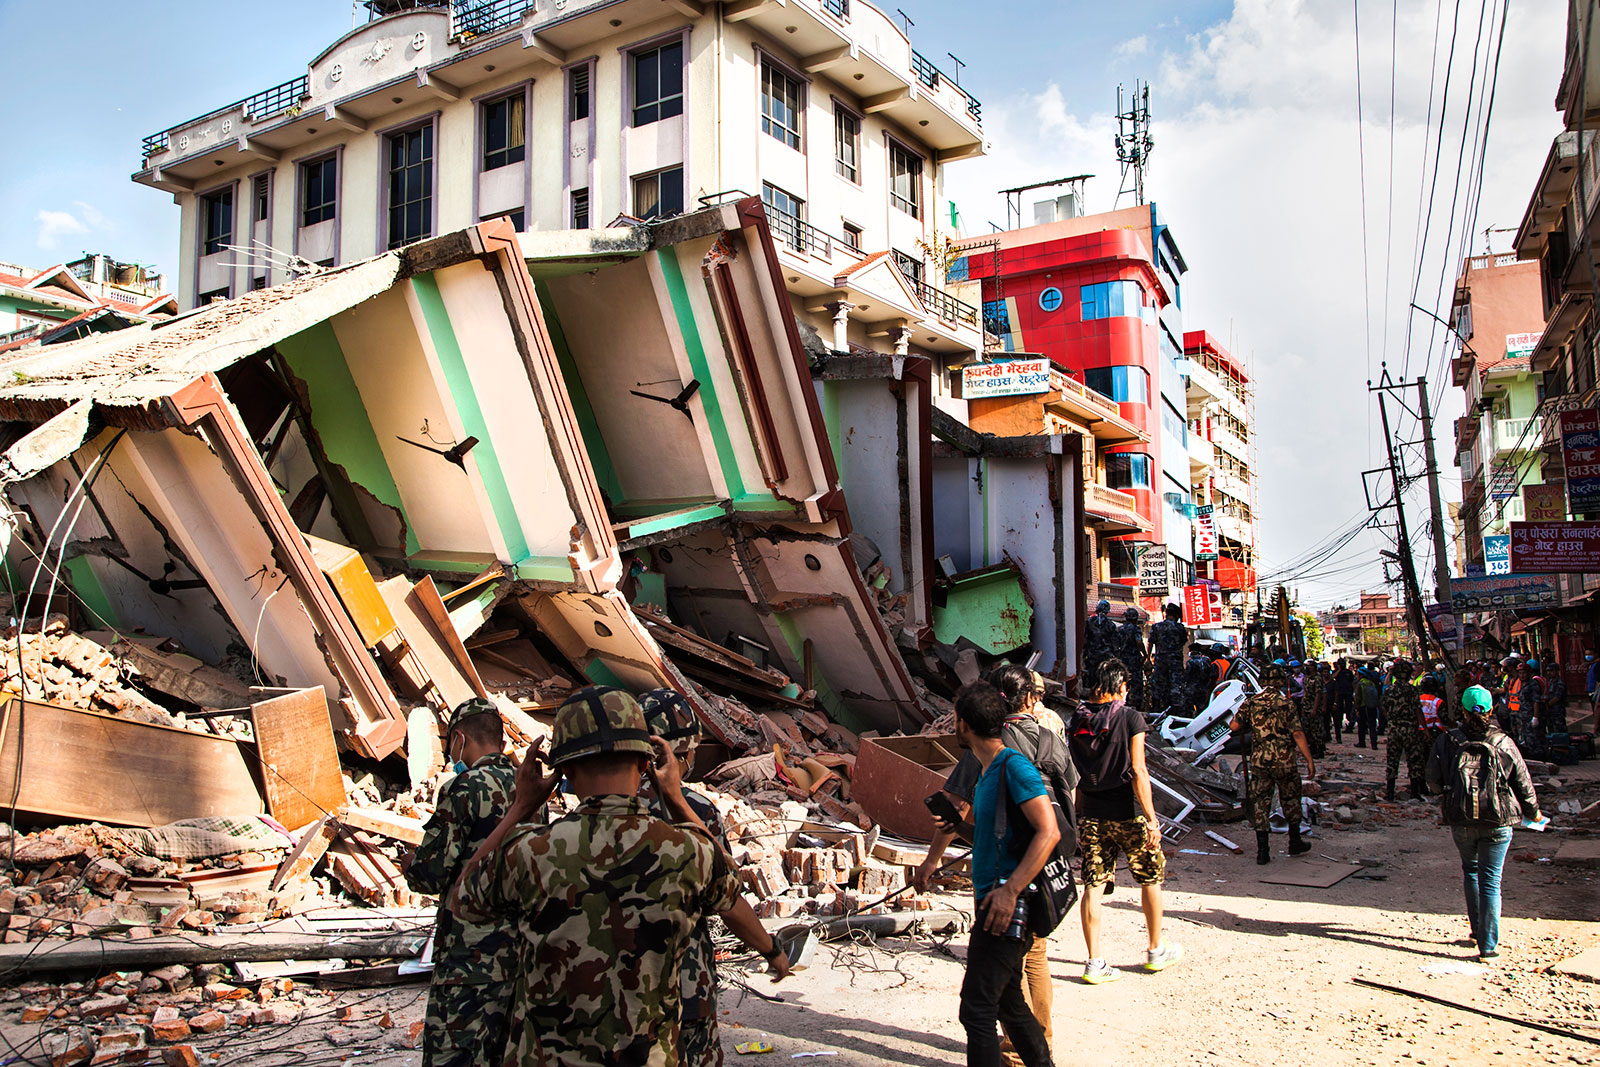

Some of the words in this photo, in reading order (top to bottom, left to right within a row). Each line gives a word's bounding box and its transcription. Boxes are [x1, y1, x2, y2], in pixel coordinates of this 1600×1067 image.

[986, 377, 1011, 387] हाउस
[1530, 525, 1559, 539] पोखरा
[1534, 539, 1555, 551] गेष्ट
[1557, 541, 1584, 551] हाउस
[1140, 578, 1167, 587] हाउस
